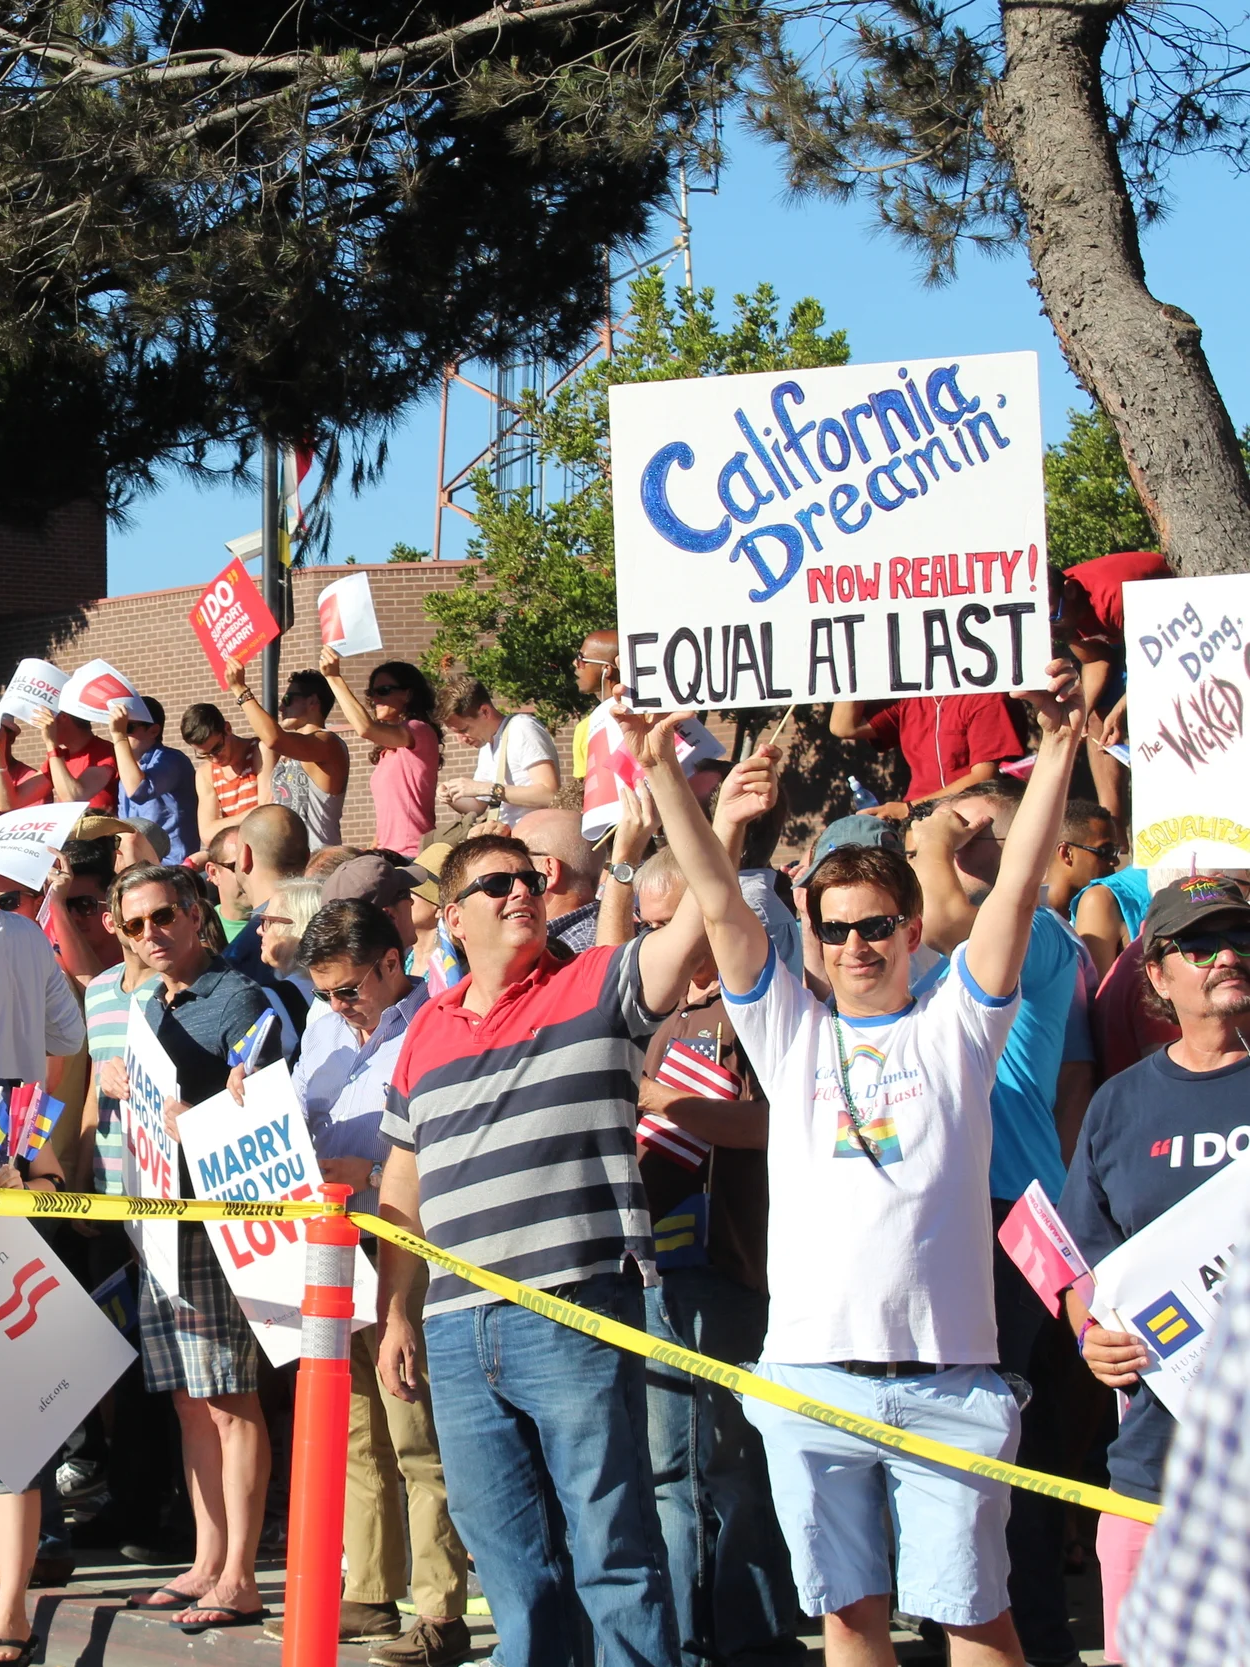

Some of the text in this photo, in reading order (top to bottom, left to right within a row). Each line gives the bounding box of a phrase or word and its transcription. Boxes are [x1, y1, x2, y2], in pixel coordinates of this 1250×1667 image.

[640, 364, 980, 554] California
[807, 543, 1037, 603] NOW REALITY!
[211, 601, 244, 642] SUPPORT
[220, 646, 229, 662] TO
[226, 621, 255, 656] MARRY
[222, 612, 250, 642] FREEDOM
[1139, 601, 1203, 668] Ding
[628, 603, 1036, 707] EQUAL AT LAST
[17, 683, 54, 705] EQUAL
[30, 677, 61, 698] LOVE
[1138, 740, 1163, 763] The
[10, 822, 58, 832] LOVE
[1137, 815, 1250, 858] EQUALITY
[126, 1045, 165, 1122] MARR
[884, 1082, 923, 1106] Last!
[127, 1107, 171, 1199] LOVE
[152, 1116, 171, 1161] YOU
[198, 1113, 292, 1192] MARRY
[1193, 1125, 1250, 1168] DO
[260, 1153, 305, 1195] YOU
[32, 1191, 92, 1214] CAUTION
[127, 1196, 188, 1215] CAUTION
[39, 1378, 70, 1412] afer.org
